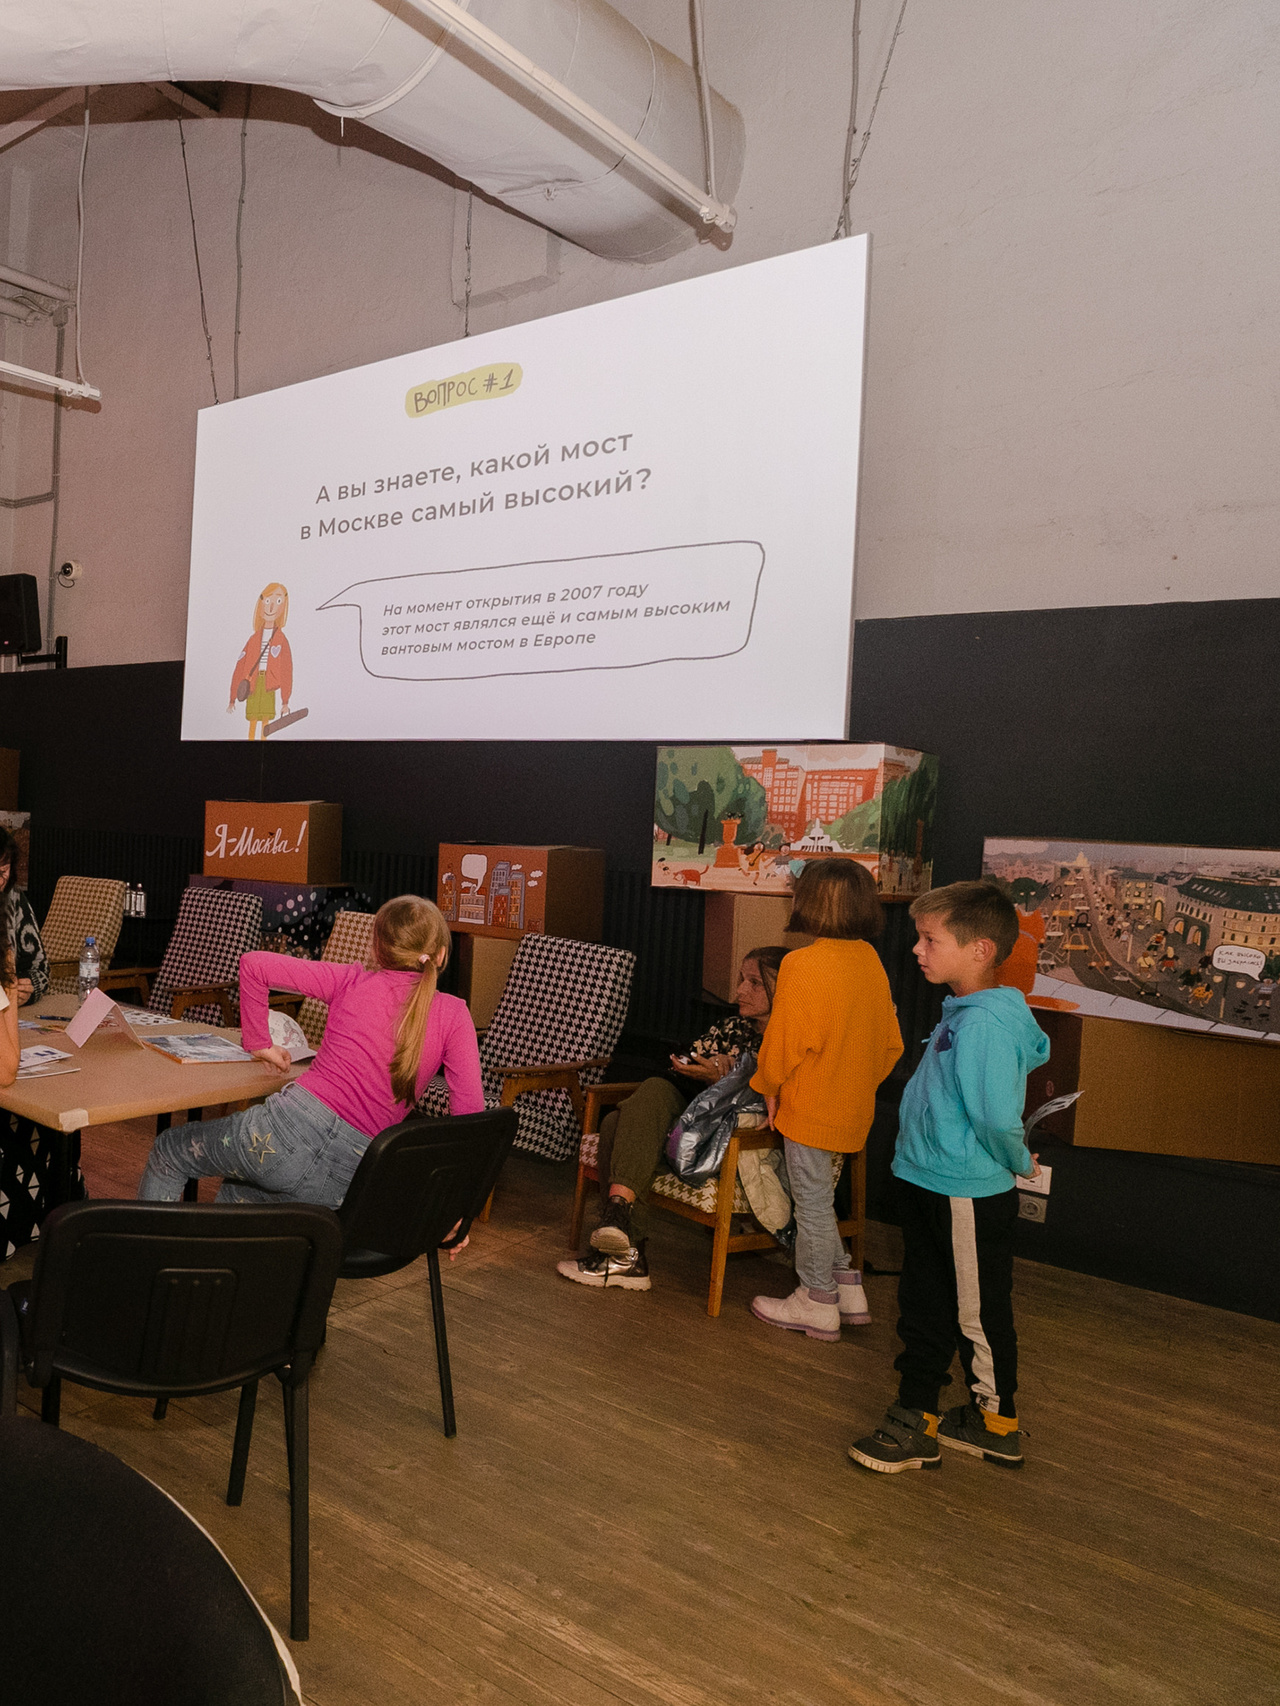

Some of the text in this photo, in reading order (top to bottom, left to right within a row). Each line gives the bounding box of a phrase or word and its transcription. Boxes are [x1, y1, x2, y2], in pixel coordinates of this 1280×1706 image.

[413, 368, 514, 413] ВОПРОС #1
[315, 433, 634, 504] А вы знаете, какой мост
[300, 467, 652, 540] в Москве самый высокий?
[381, 600, 731, 637] этот мост являлся ещё и самым высоким
[383, 583, 650, 617] На момент открытия в 2007 году
[381, 633, 597, 656] вантовым мостом в Европе
